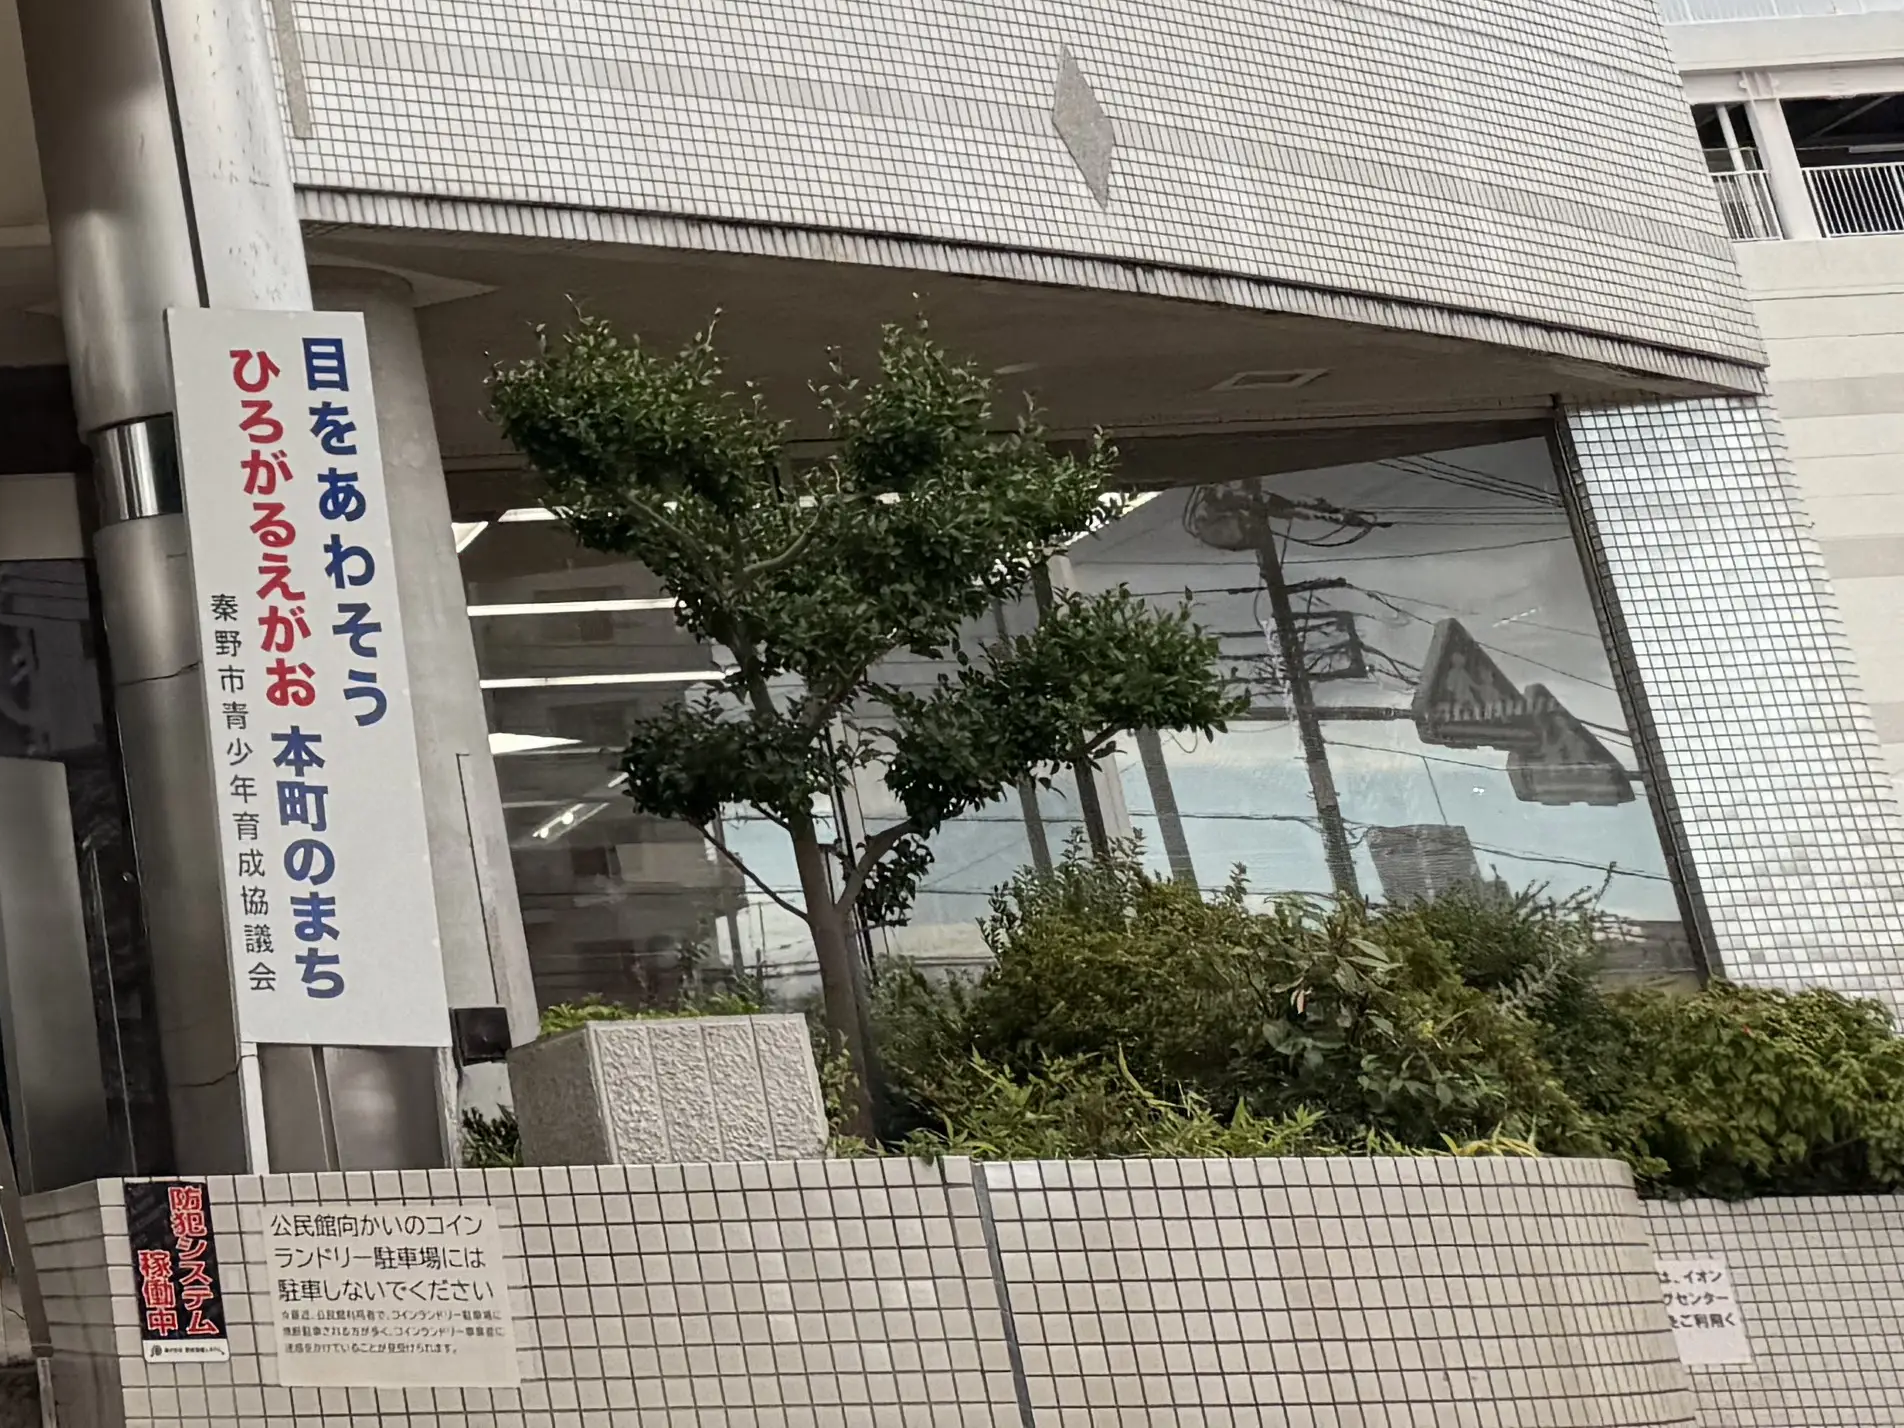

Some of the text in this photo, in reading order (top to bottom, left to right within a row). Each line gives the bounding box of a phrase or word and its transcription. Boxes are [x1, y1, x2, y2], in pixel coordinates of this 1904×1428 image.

[301, 336, 388, 727] 目をあわそう
[229, 348, 345, 1000] ひろがるえがお 本町のまち
[209, 593, 277, 992] 秦野市青少年育成協議会
[168, 1185, 220, 1335] 防犯システム
[270, 1213, 483, 1238] 公民館向かいのコイン
[274, 1246, 487, 1270] ランドリー駐車場には
[138, 1249, 179, 1337] 稼働中
[277, 1278, 495, 1303] 駐車しないでください
